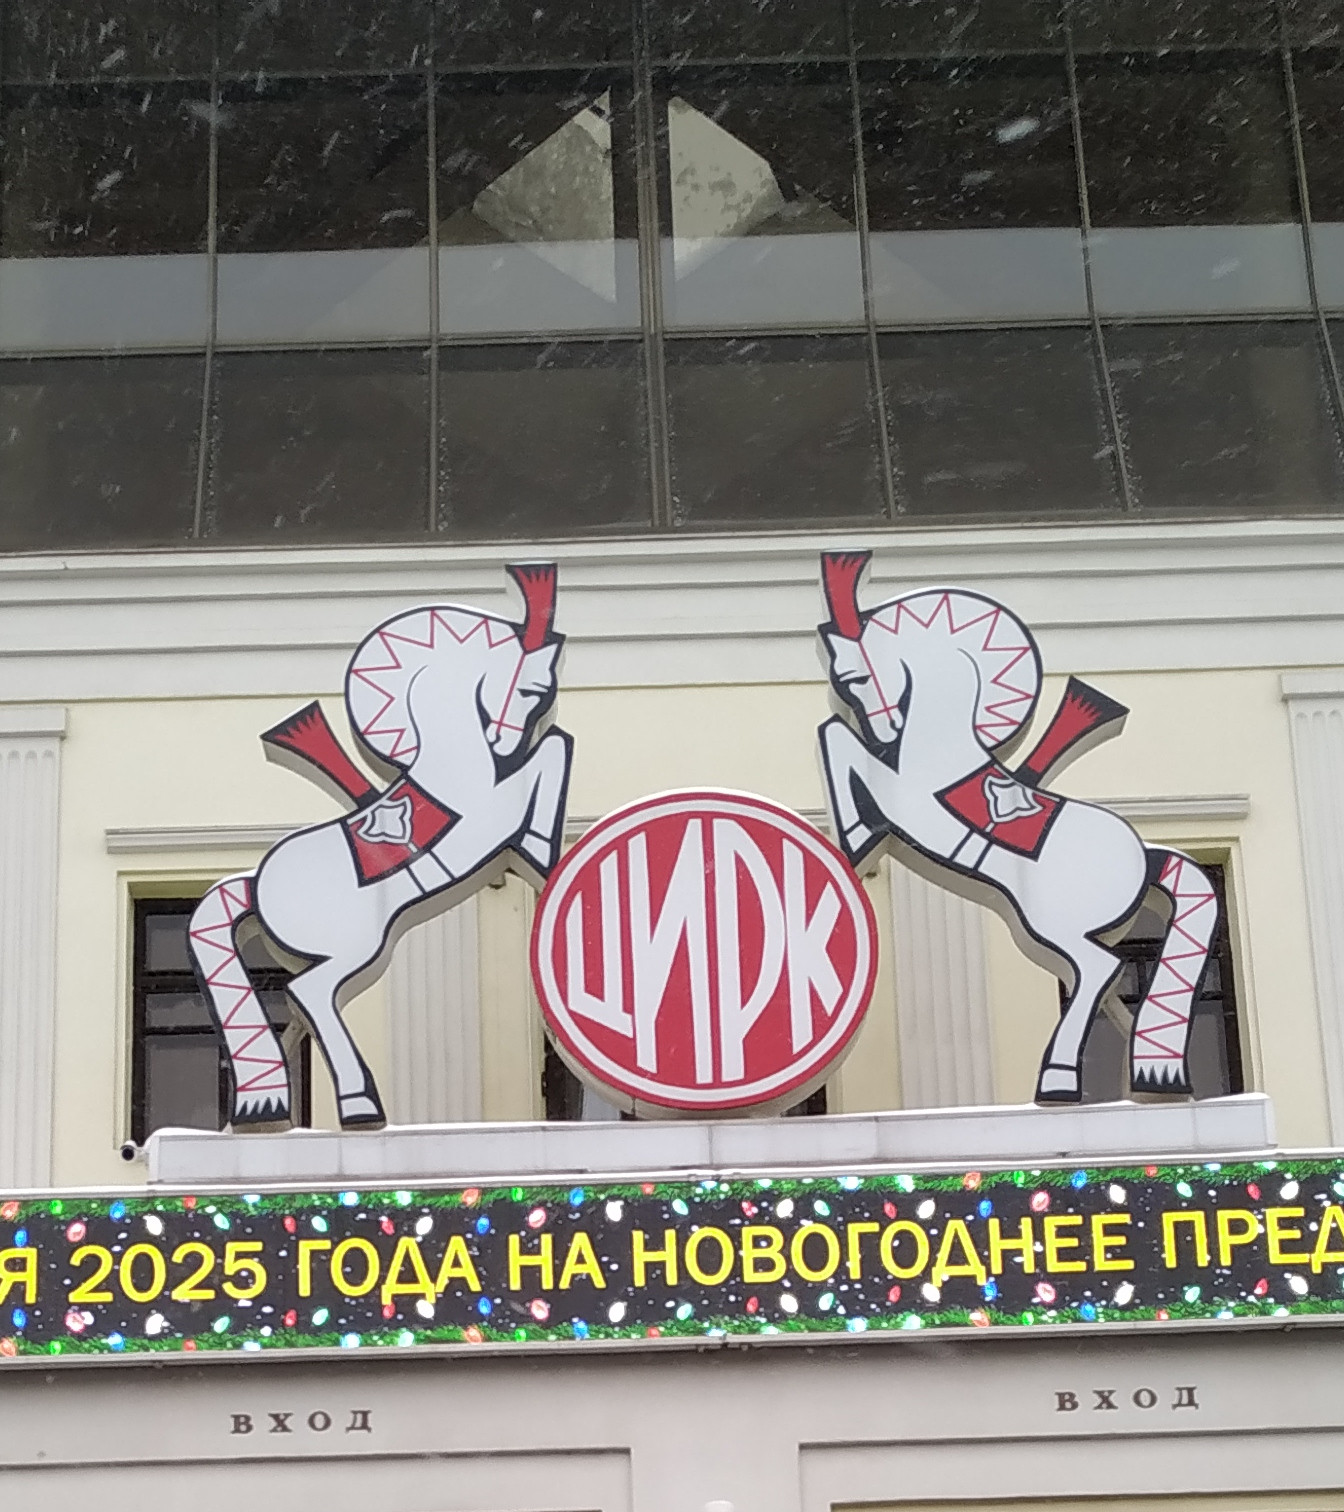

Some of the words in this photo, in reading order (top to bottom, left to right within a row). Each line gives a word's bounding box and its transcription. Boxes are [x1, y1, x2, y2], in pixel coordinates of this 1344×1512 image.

[566, 817, 844, 1084] ЦИРК
[68, 1241, 267, 1303] 2025
[298, 1235, 482, 1305] ГОДА
[508, 1231, 606, 1291] НА
[632, 1213, 1135, 1288] НОВОГОДНЕЕ
[230, 1410, 372, 1434] ВХОД
[1055, 1386, 1199, 1412] ВХОД
